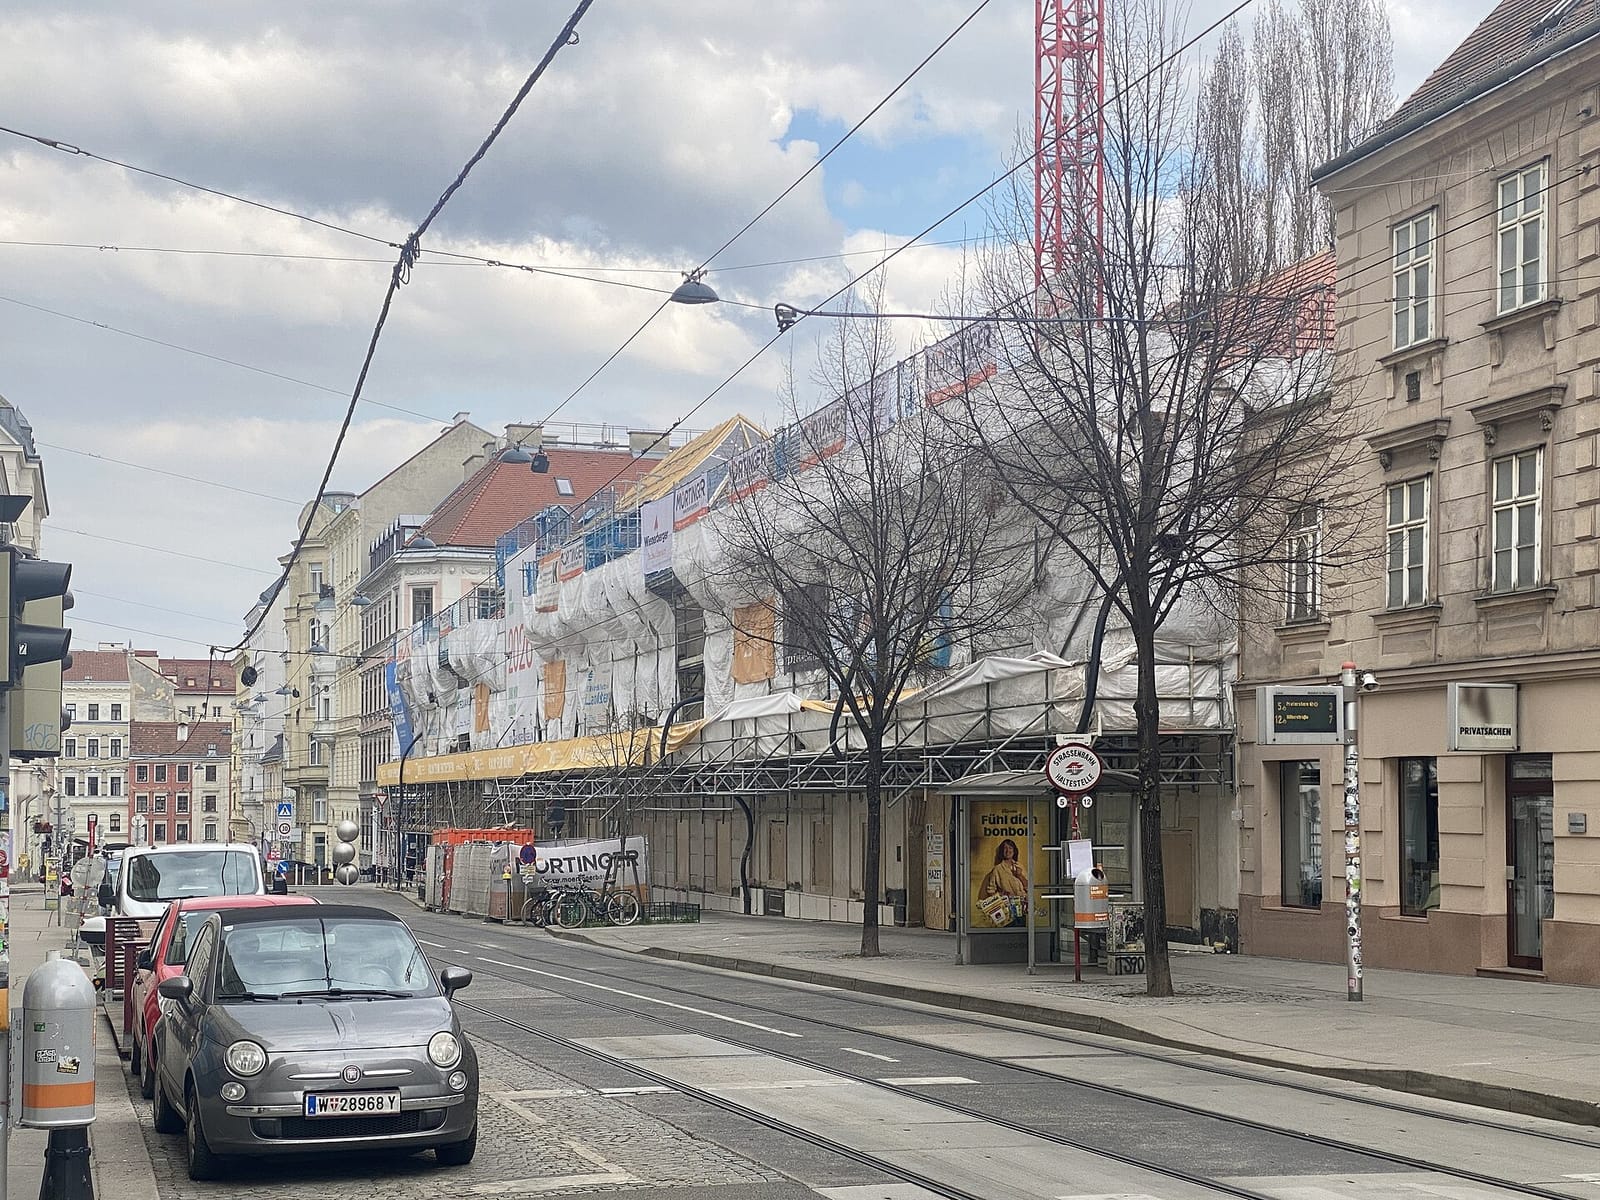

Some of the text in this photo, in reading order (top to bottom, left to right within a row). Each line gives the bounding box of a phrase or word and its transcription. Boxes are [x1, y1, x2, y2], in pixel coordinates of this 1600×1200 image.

[1459, 726, 1512, 736] PRIVATSACHEN
[1053, 749, 1097, 767] STRASSENBAHN
[1055, 773, 1095, 788] HALTESTELLE
[1059, 799, 1091, 807] 5 12
[981, 813, 1008, 825] Fühl
[318, 1097, 329, 1112] W
[340, 1096, 384, 1111] 28968
[387, 1095, 396, 1110] Y
